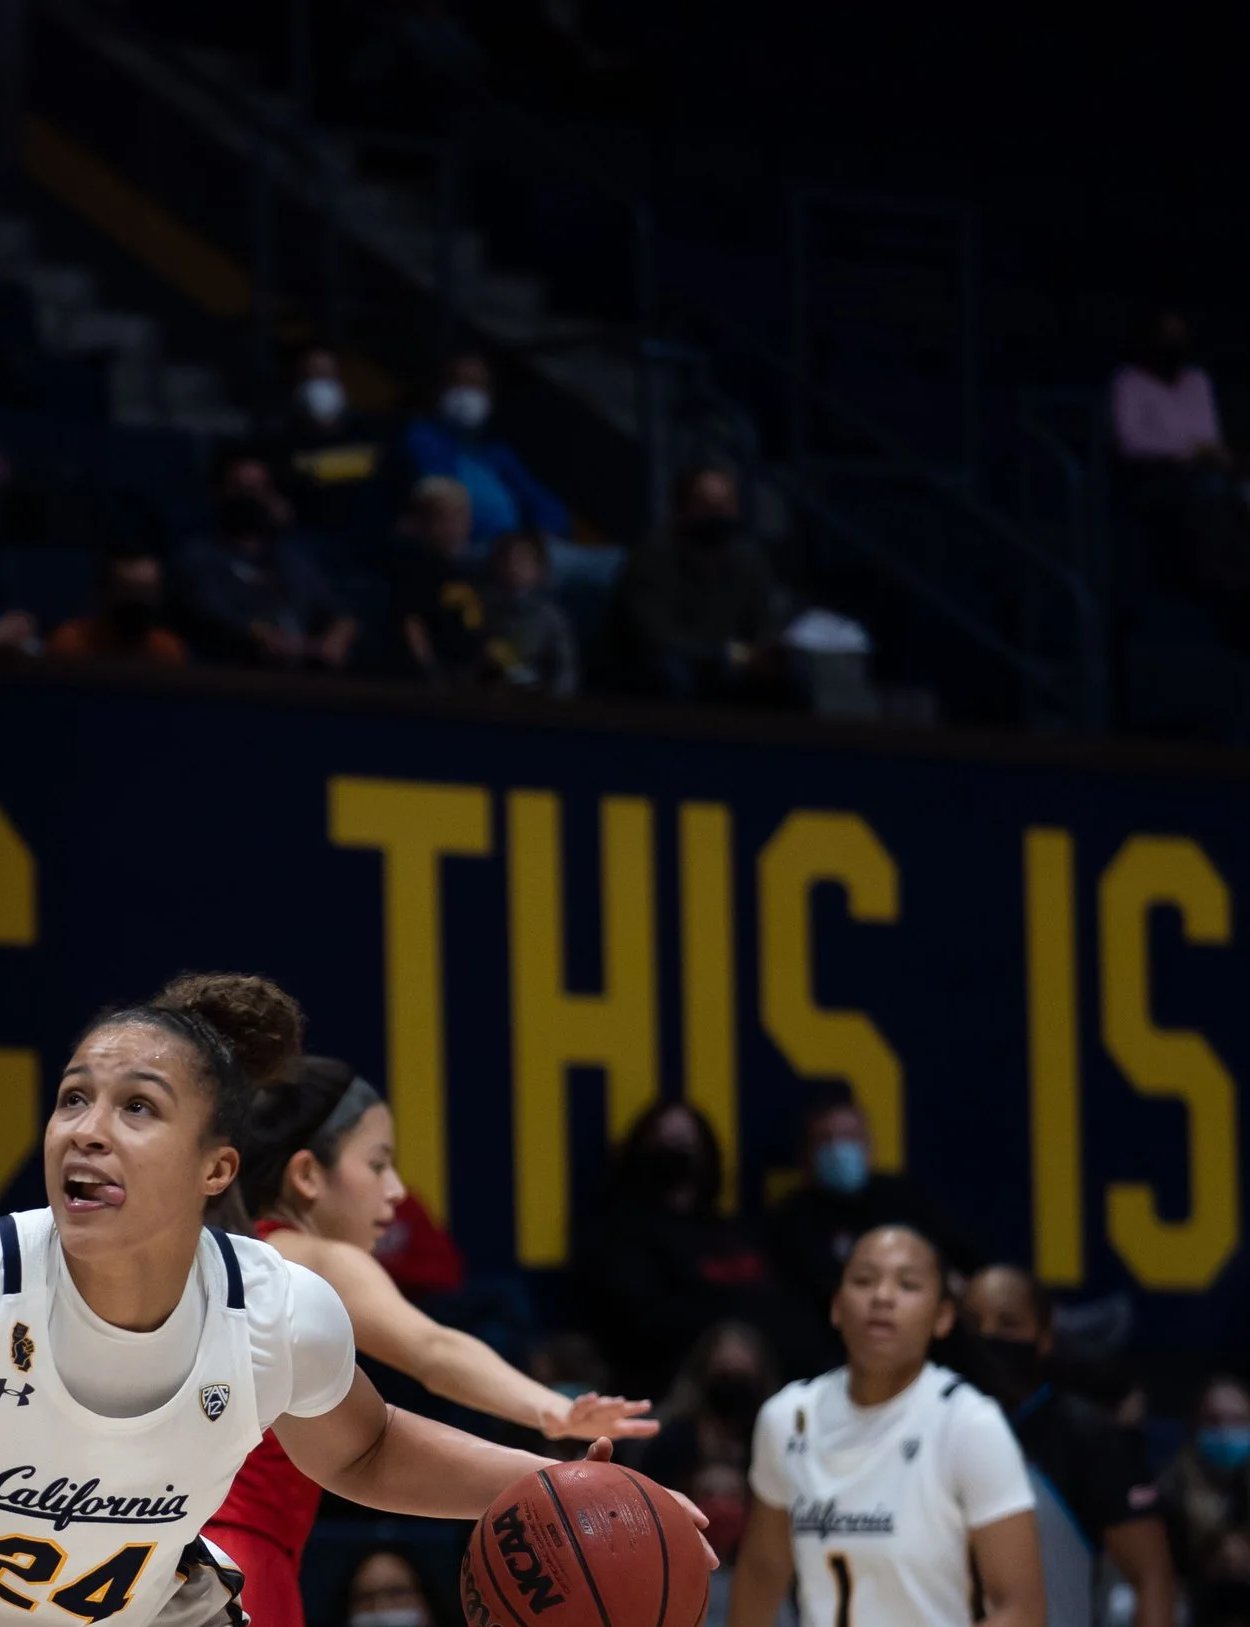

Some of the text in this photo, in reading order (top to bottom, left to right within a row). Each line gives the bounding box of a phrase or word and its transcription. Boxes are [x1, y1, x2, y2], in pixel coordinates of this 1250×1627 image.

[326, 773, 1244, 1295] THIS IS
[492, 1502, 566, 1616] NCAA
